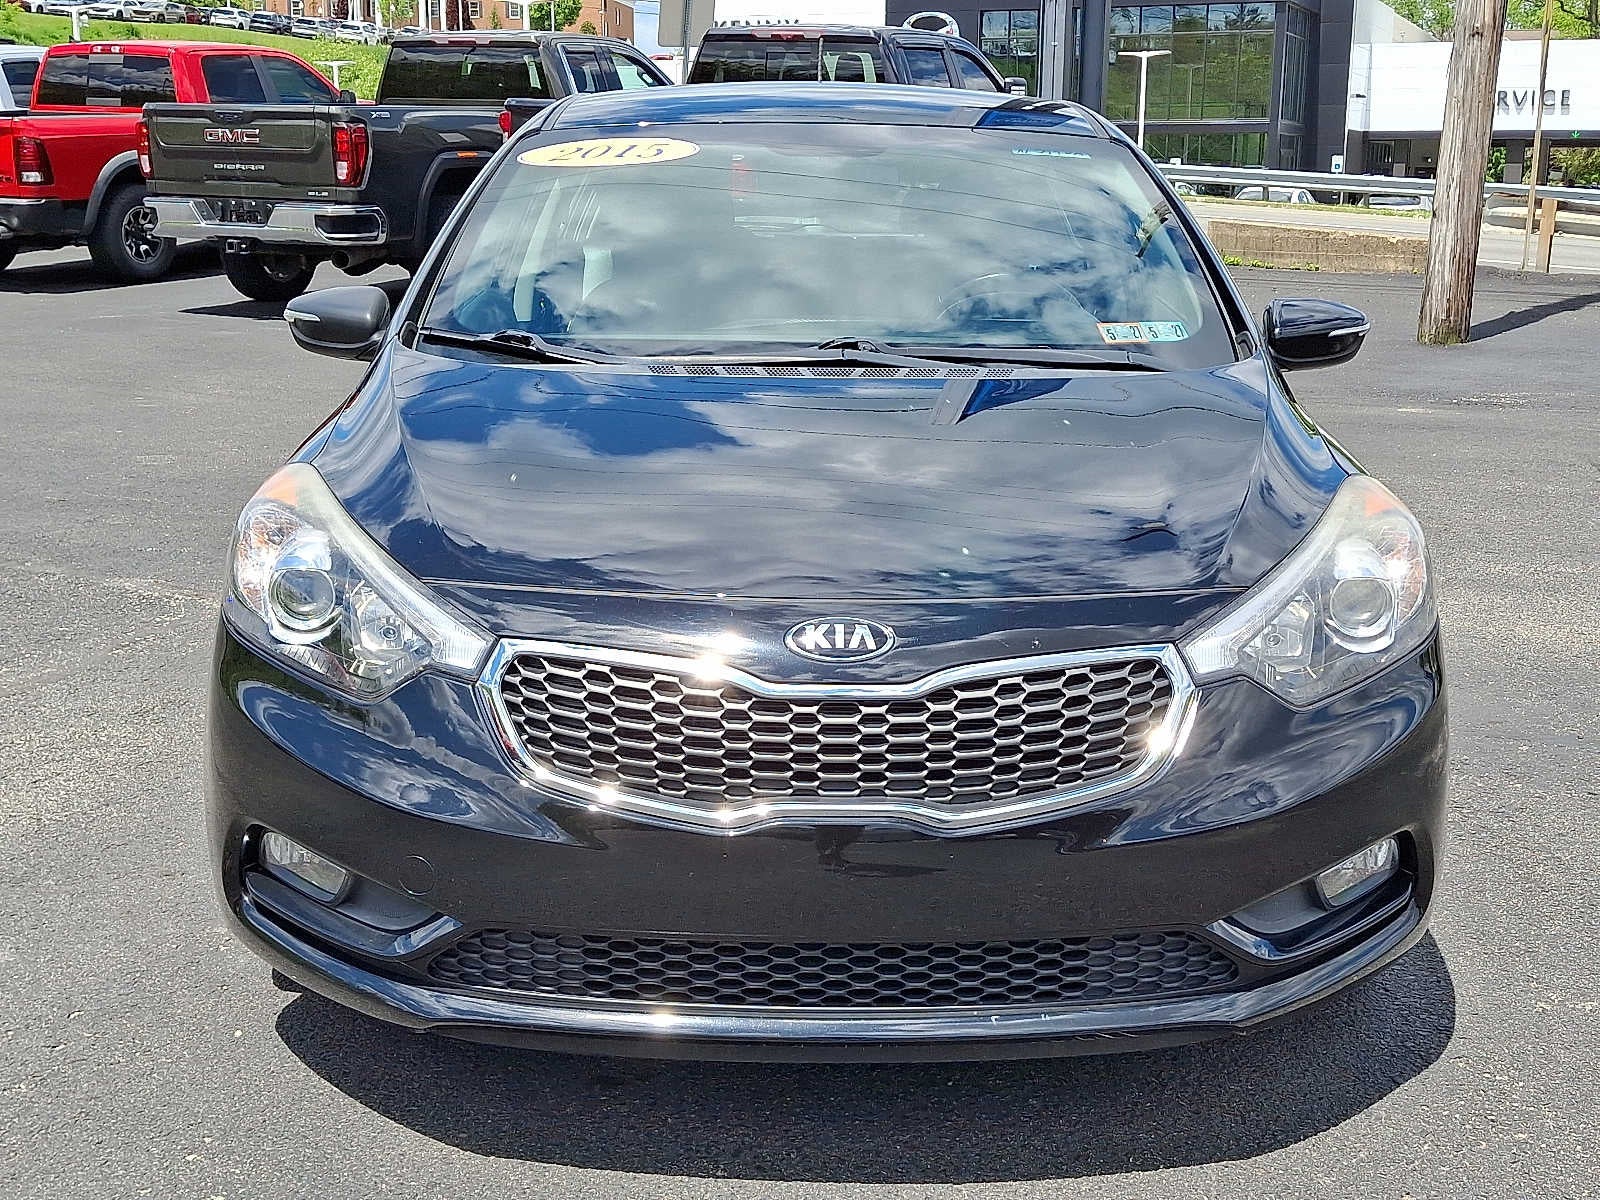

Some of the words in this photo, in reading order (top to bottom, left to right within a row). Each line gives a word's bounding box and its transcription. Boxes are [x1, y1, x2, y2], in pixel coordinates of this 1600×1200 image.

[1497, 89, 1570, 107] RVICE
[203, 128, 260, 143] GMC
[548, 143, 670, 162] 2015
[213, 163, 265, 171] SIERRA
[1106, 327, 1117, 341] 5
[1148, 326, 1159, 339] 5
[801, 623, 877, 650] KIA
